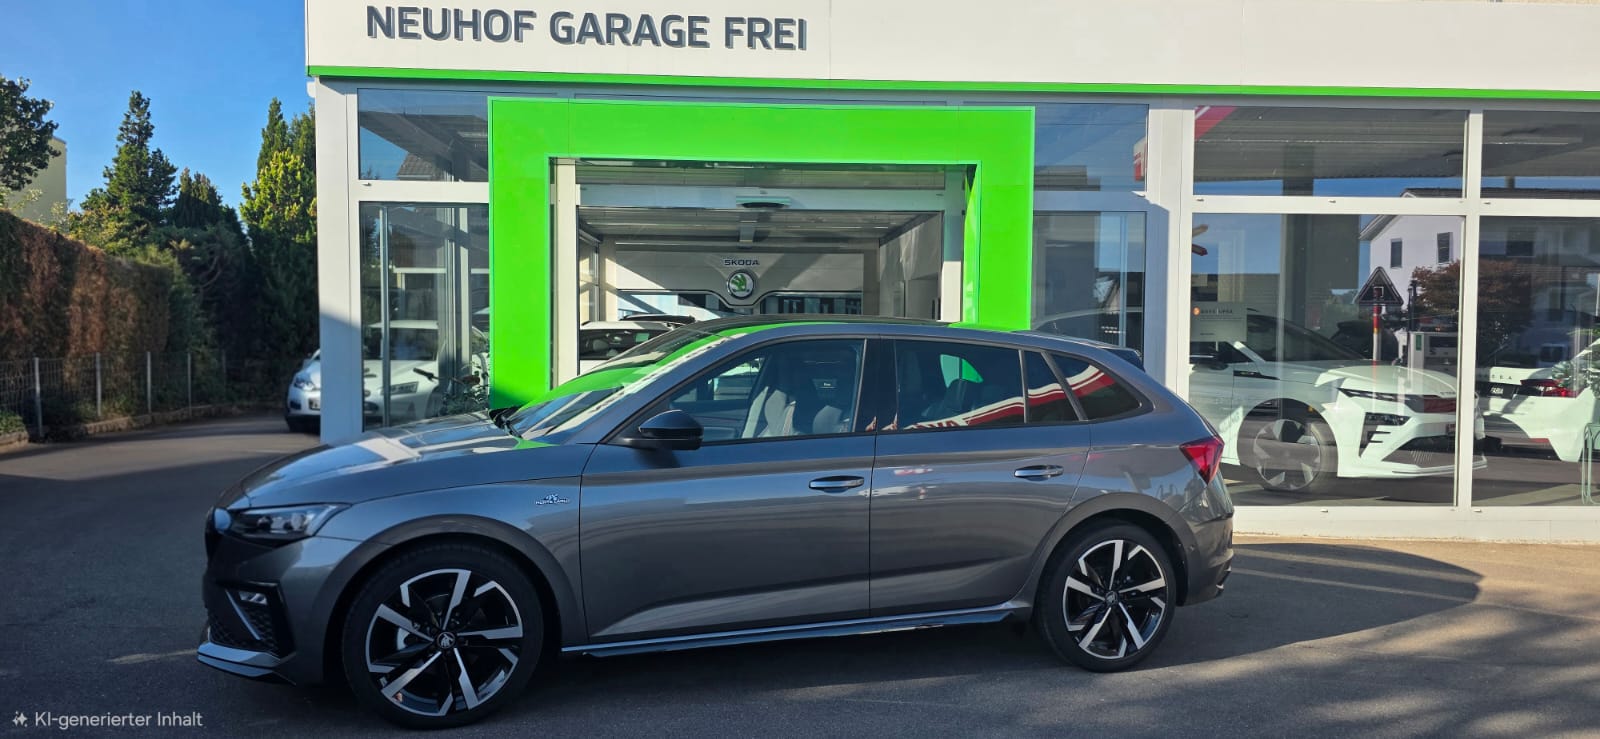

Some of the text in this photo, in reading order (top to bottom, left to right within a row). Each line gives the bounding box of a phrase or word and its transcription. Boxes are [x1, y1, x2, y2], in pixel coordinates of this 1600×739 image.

[366, 5, 807, 51] NEUHOF GARAGE FREI
